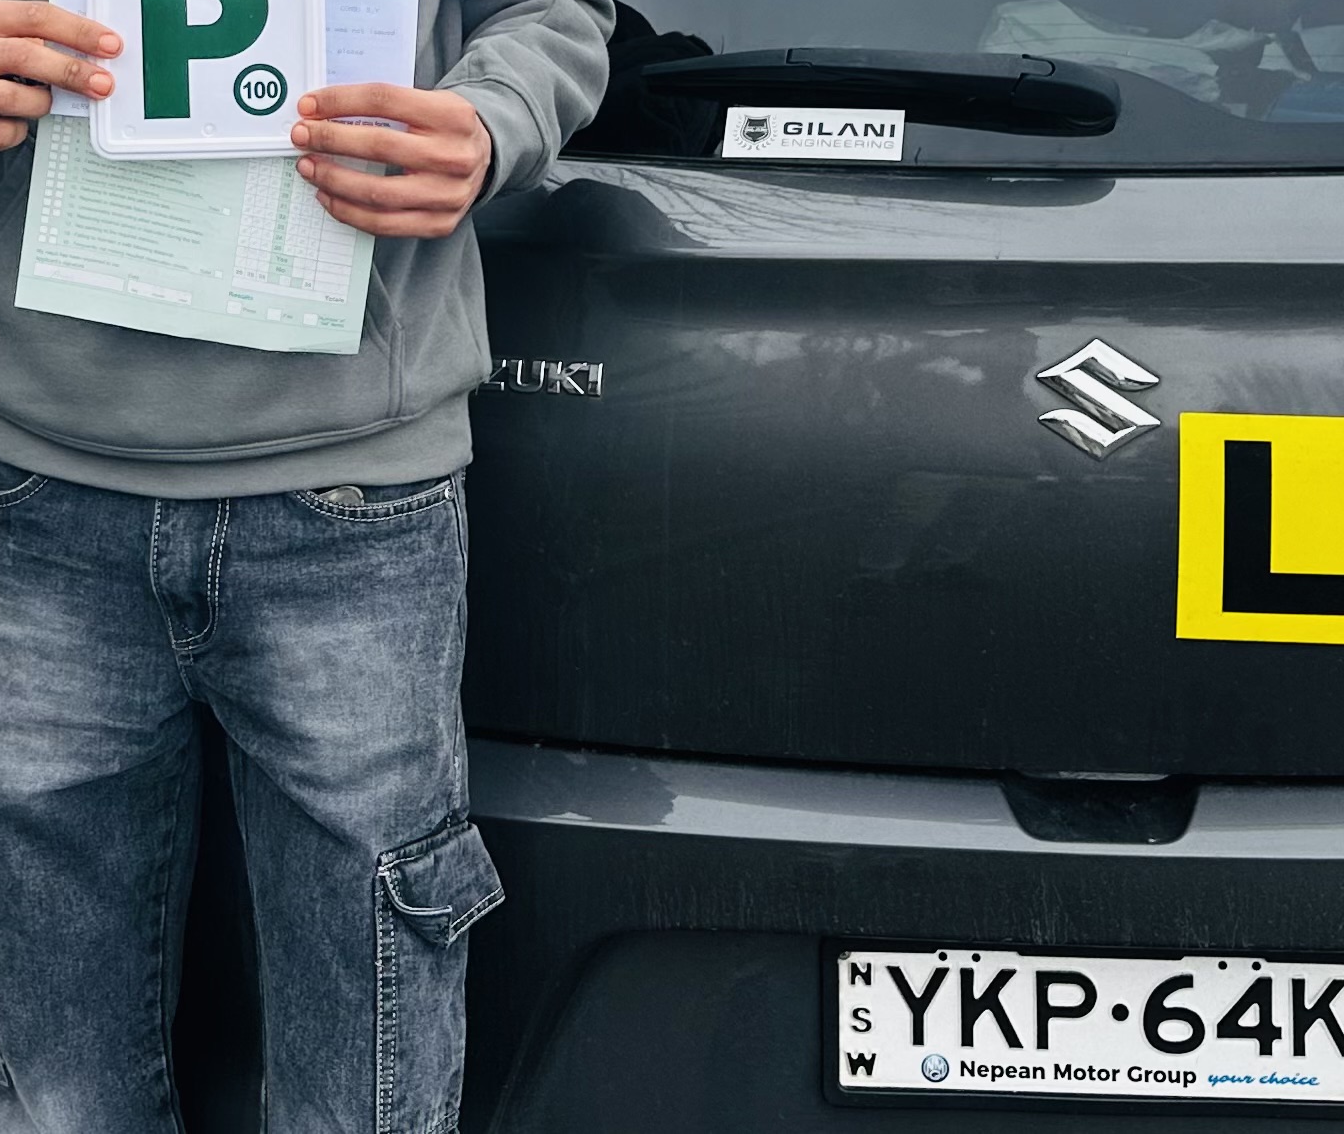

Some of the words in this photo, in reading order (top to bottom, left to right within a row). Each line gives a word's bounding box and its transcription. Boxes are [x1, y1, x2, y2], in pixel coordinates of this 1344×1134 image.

[241, 78, 280, 102] 100
[782, 121, 896, 138] GILANI
[780, 138, 895, 150] ENGINEERING
[960, 1059, 1046, 1082] Nepean
[1053, 1061, 1121, 1083] Motor
[1126, 1065, 1197, 1088] Group
[1207, 1073, 1256, 1088] your
[1257, 1071, 1321, 1086] choice
